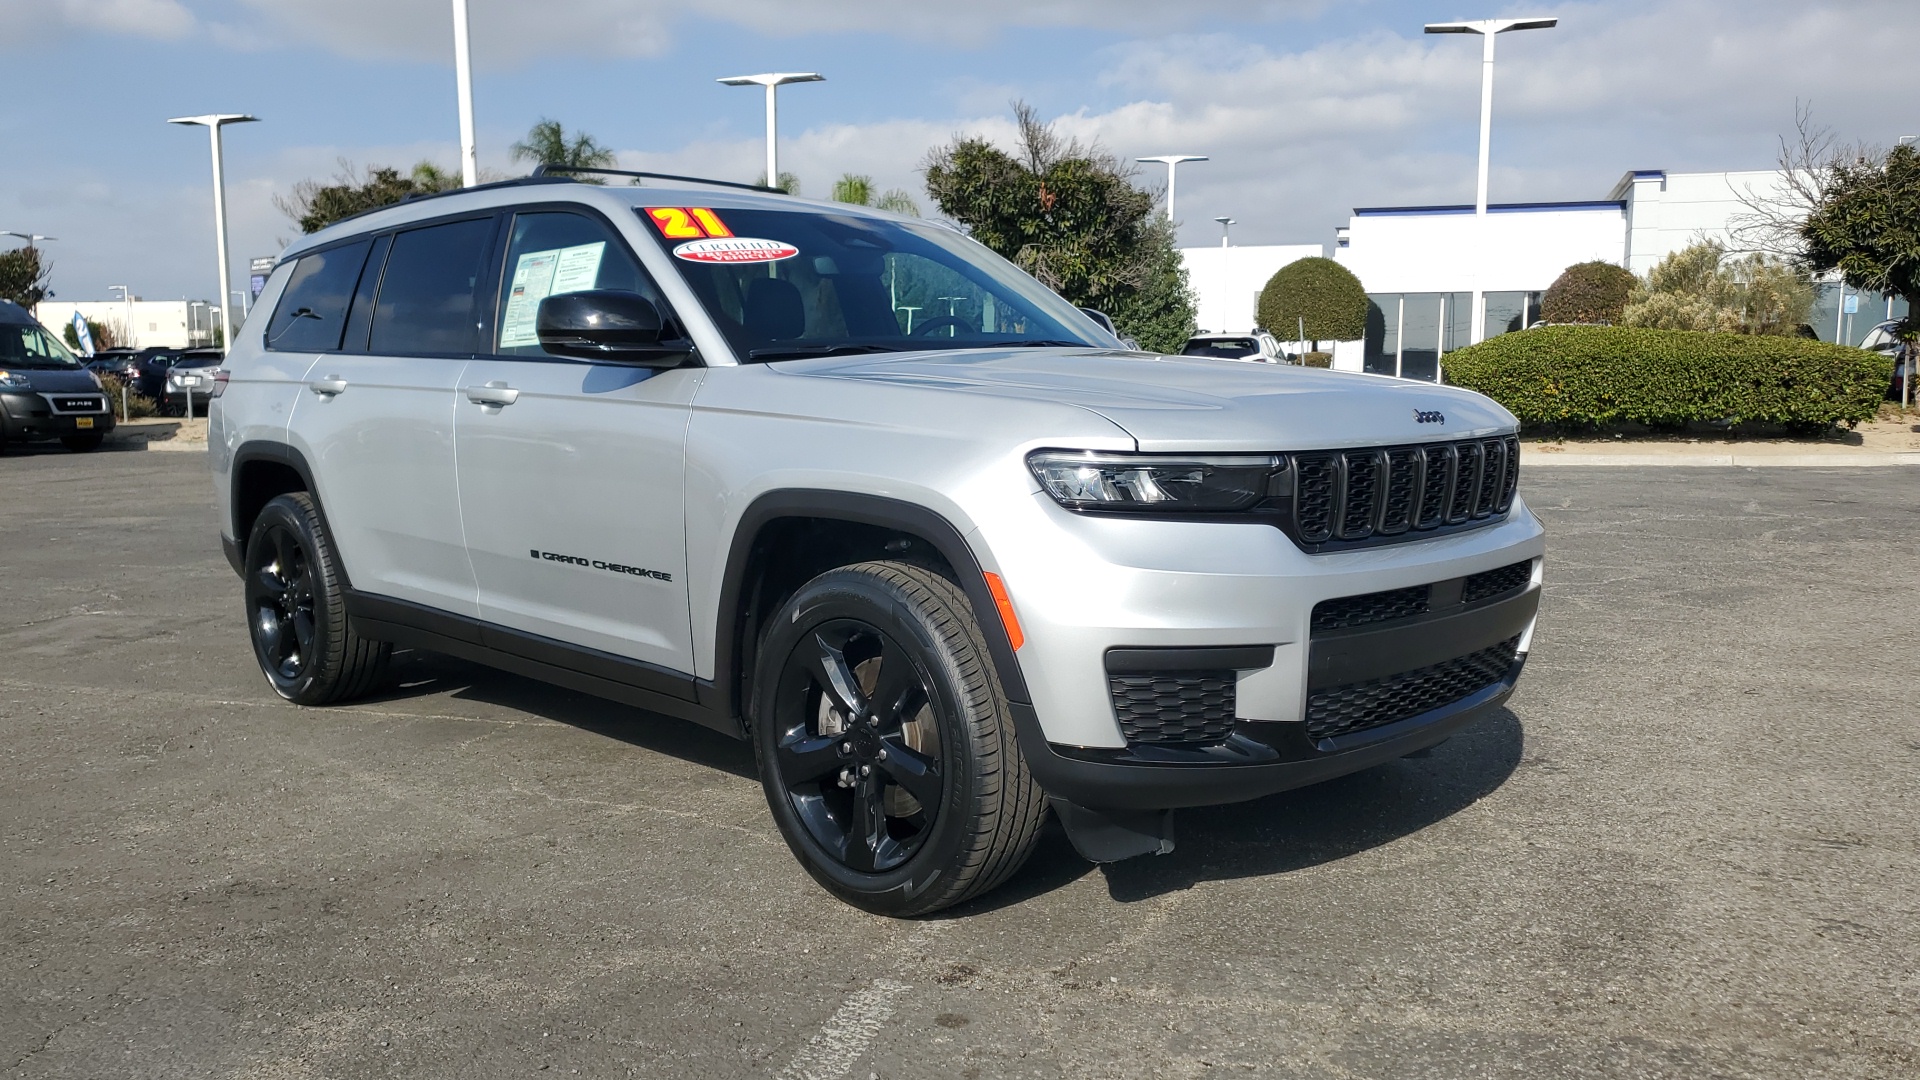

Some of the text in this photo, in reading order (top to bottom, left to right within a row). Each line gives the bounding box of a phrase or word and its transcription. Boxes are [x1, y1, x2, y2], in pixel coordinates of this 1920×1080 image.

[652, 208, 729, 237] 21
[686, 242, 781, 252] CERTIFIED
[696, 249, 783, 258] PRE-OWNED
[1412, 408, 1445, 426] Jeep
[541, 551, 673, 583] GRAND CHEROKEE
